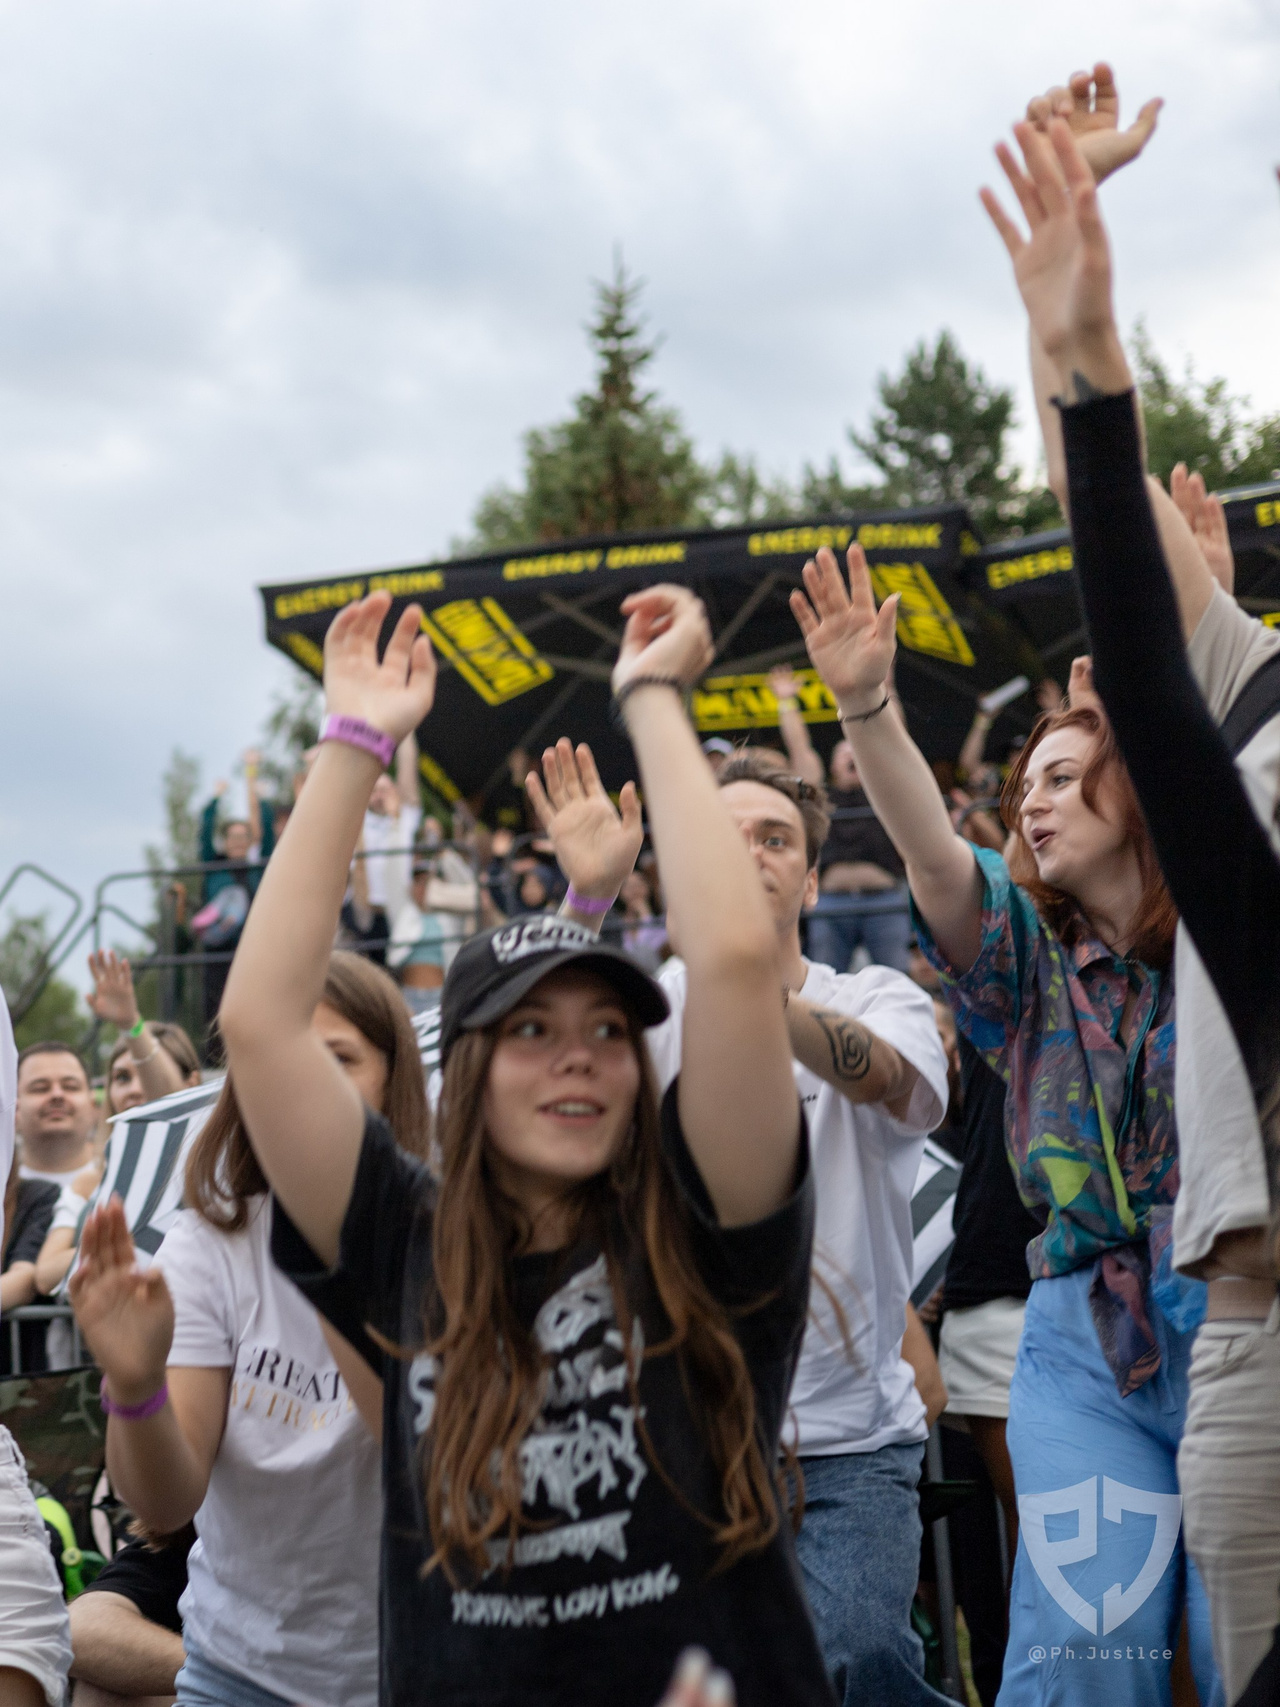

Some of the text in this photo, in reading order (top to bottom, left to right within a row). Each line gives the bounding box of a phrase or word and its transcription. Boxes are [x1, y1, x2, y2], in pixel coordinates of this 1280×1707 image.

[748, 525, 853, 556] ENERGY
[857, 522, 942, 550] DRINK
[502, 541, 687, 581] ENERGY DRINK
